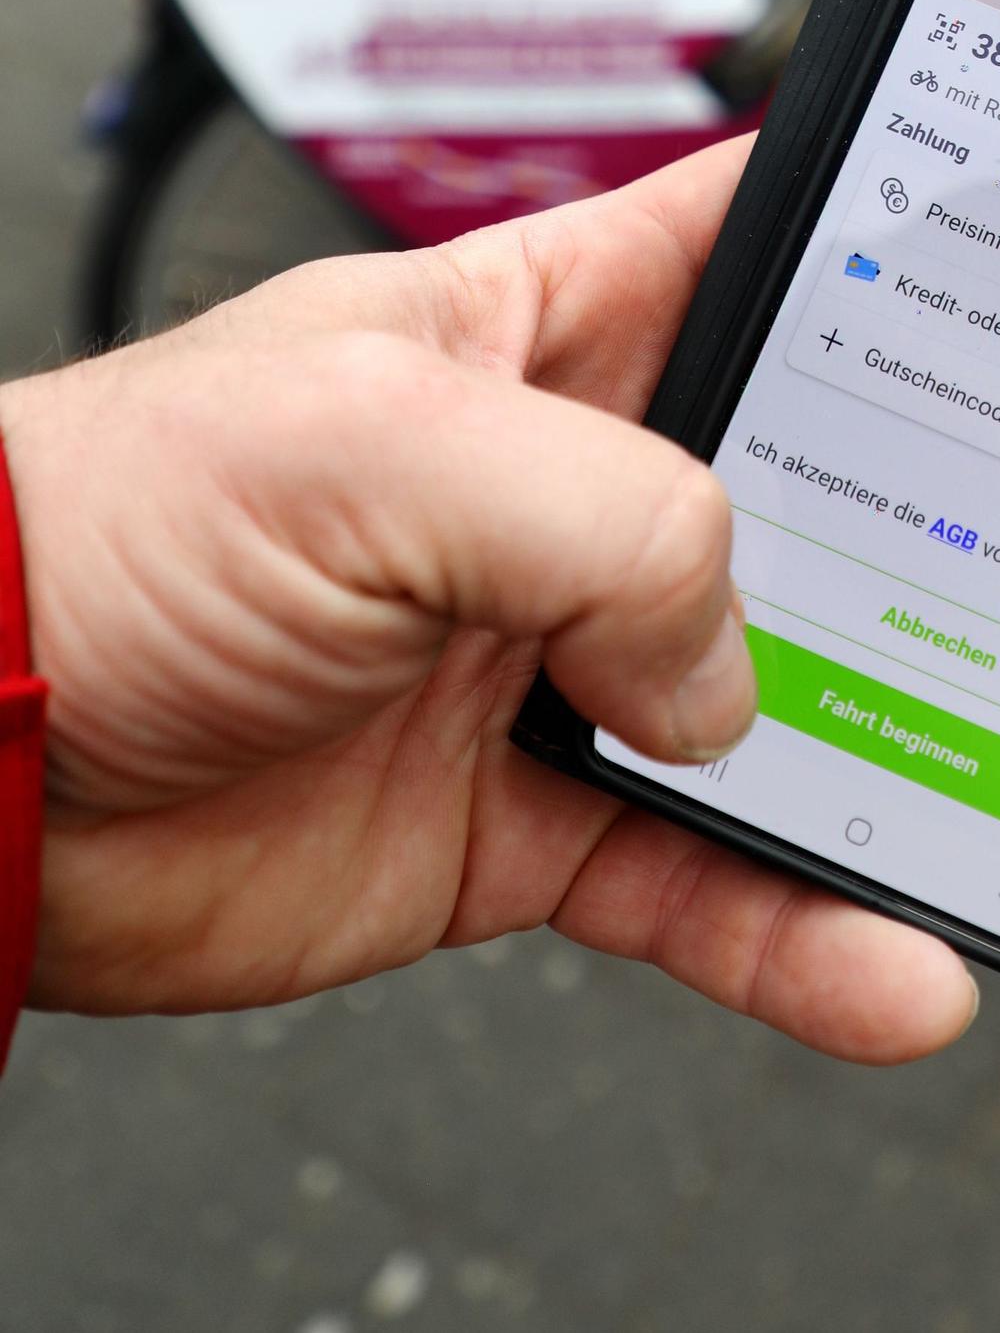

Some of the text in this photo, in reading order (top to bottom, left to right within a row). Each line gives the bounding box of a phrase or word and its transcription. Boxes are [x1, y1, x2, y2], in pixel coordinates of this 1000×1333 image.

[945, 86, 980, 110] mit
[886, 112, 970, 165] Zahlung
[894, 274, 963, 314] Kredit-
[745, 435, 778, 465] Ich
[782, 455, 890, 513] akzeptiere
[893, 503, 926, 529] die
[927, 517, 979, 554] AGB
[880, 606, 997, 671] Abbrechen
[818, 689, 979, 776] Fahrt beginnen
